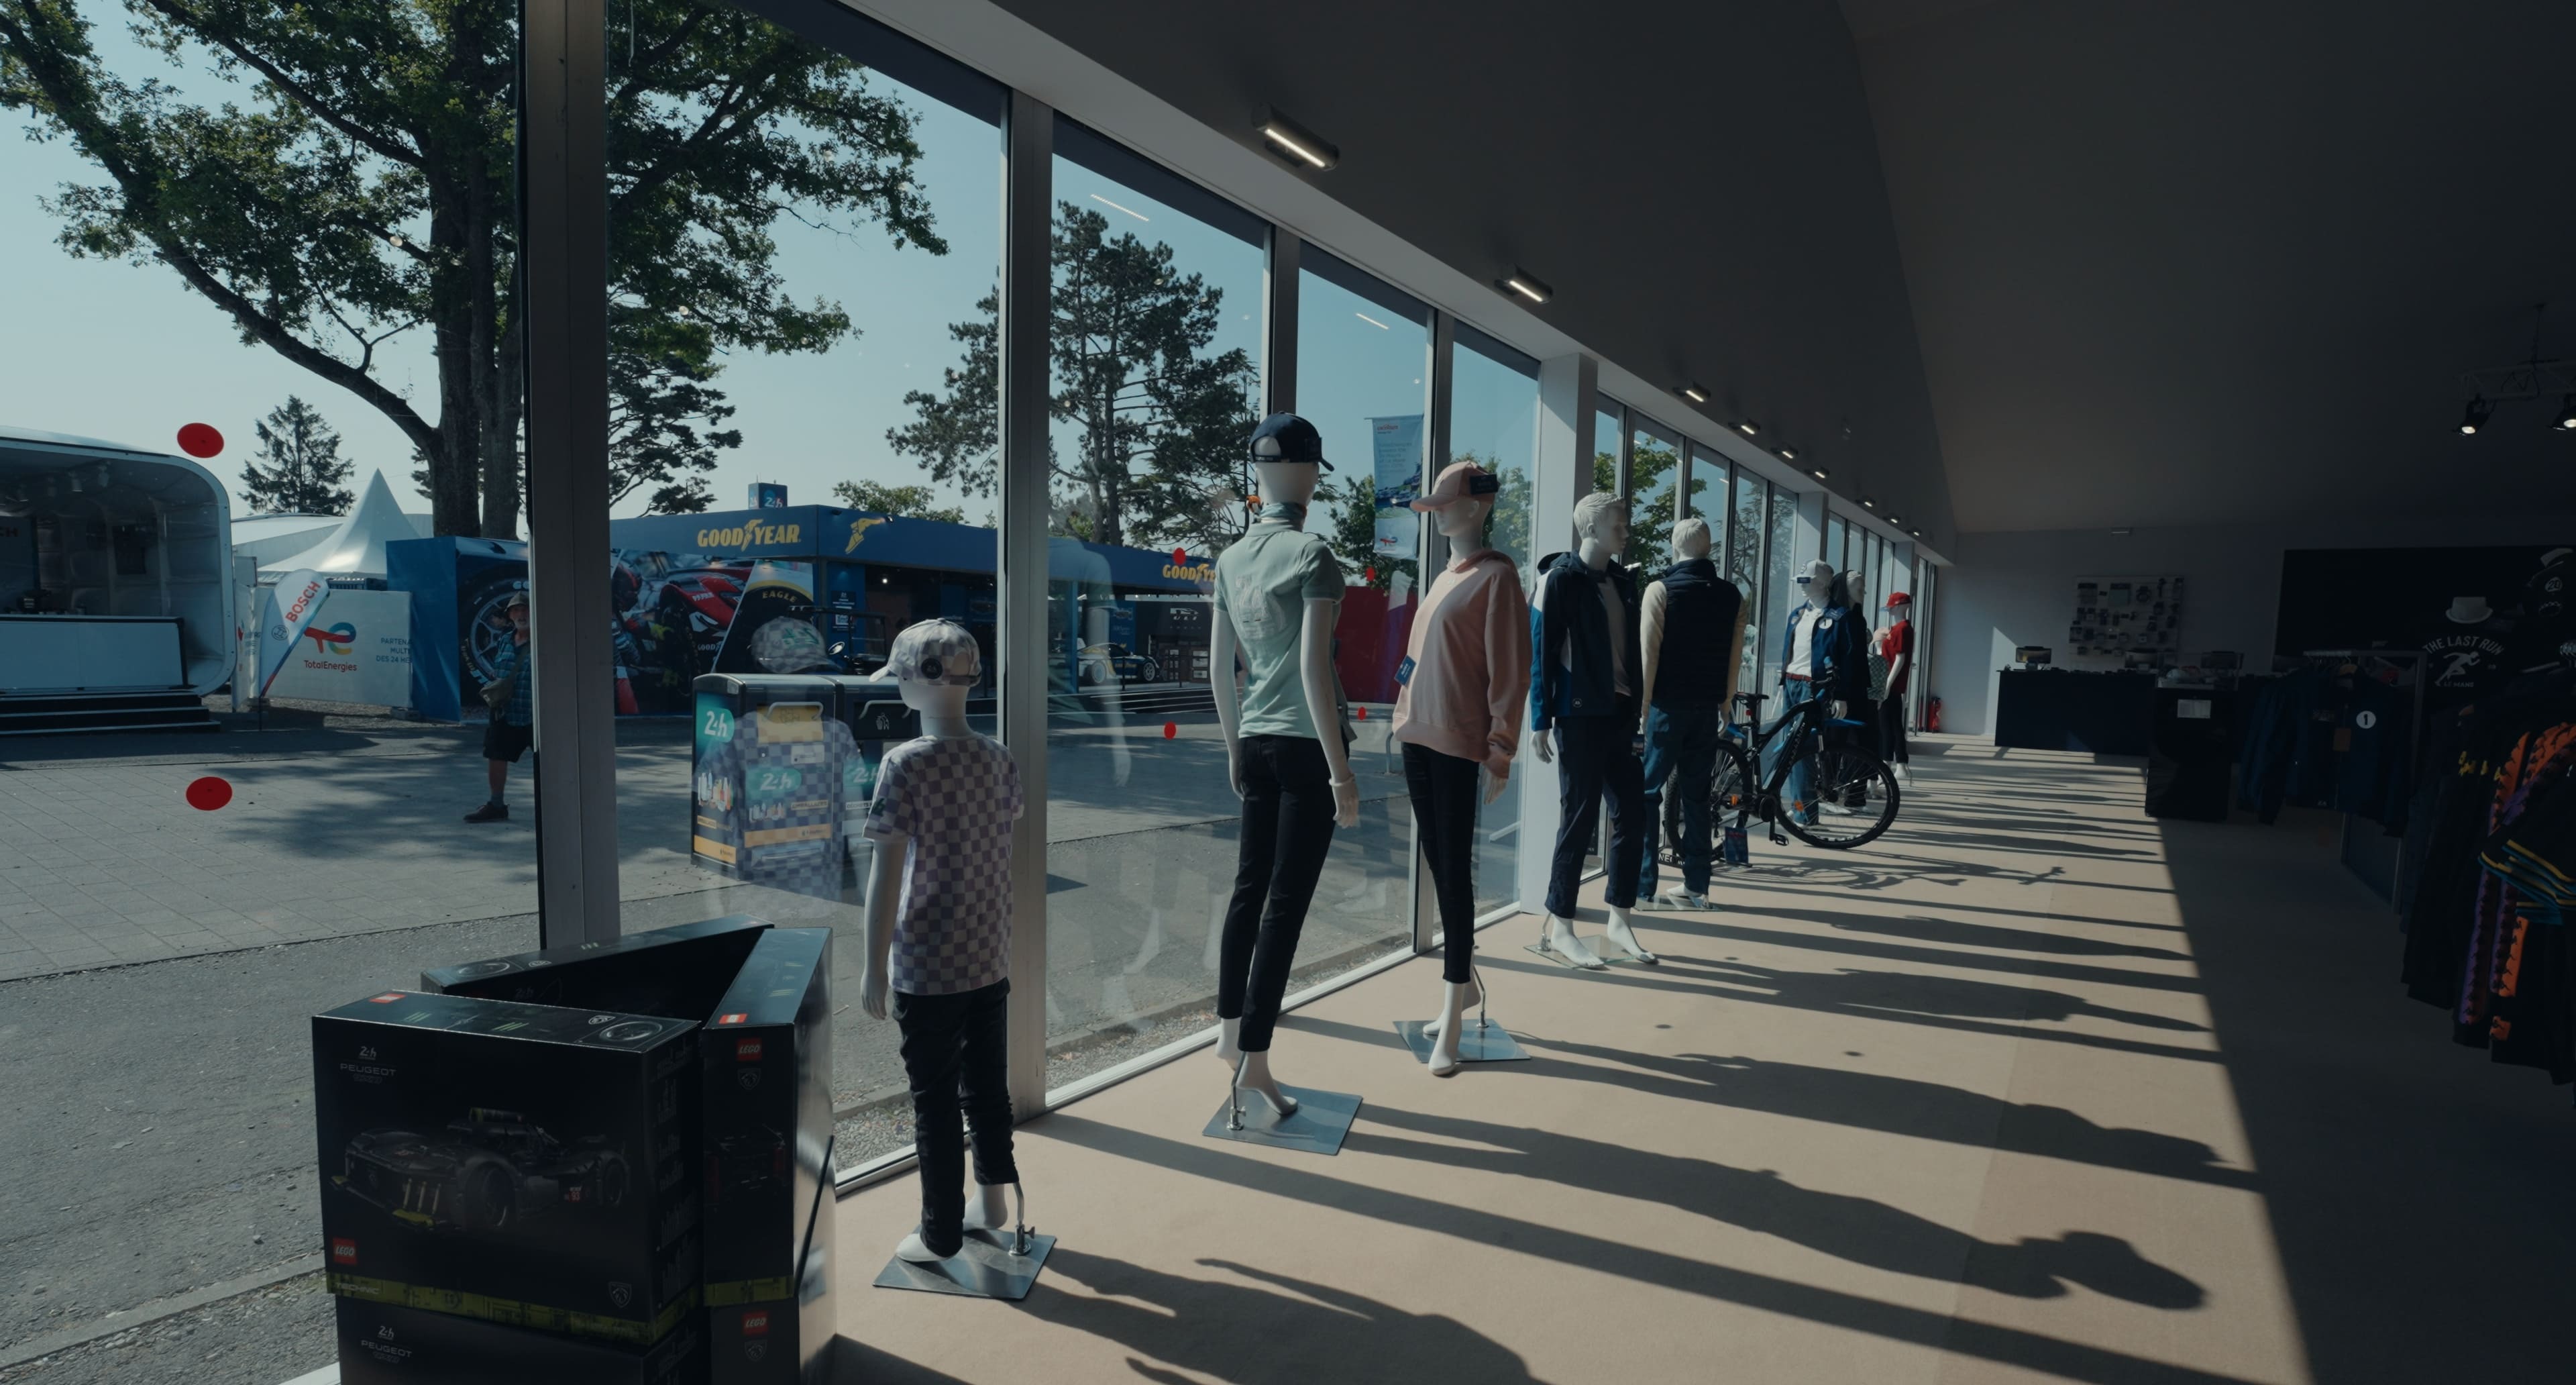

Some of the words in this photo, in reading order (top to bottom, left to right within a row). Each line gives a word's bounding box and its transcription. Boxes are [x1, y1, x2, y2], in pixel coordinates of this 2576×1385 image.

[697, 521, 801, 550] GOODYEAR
[286, 581, 321, 623] BOSCH
[762, 590, 798, 603] EAGLE
[2422, 638, 2446, 654] THE
[2447, 635, 2480, 648] LAST
[2478, 638, 2505, 656] RUN
[303, 660, 358, 673] TotalEnergies
[740, 1045, 761, 1054] LEGO
[339, 1063, 397, 1077] PEUGEOT
[335, 1245, 356, 1258] LEGO
[745, 1317, 767, 1329] LEGO
[361, 1339, 413, 1358] PEUGEOT
